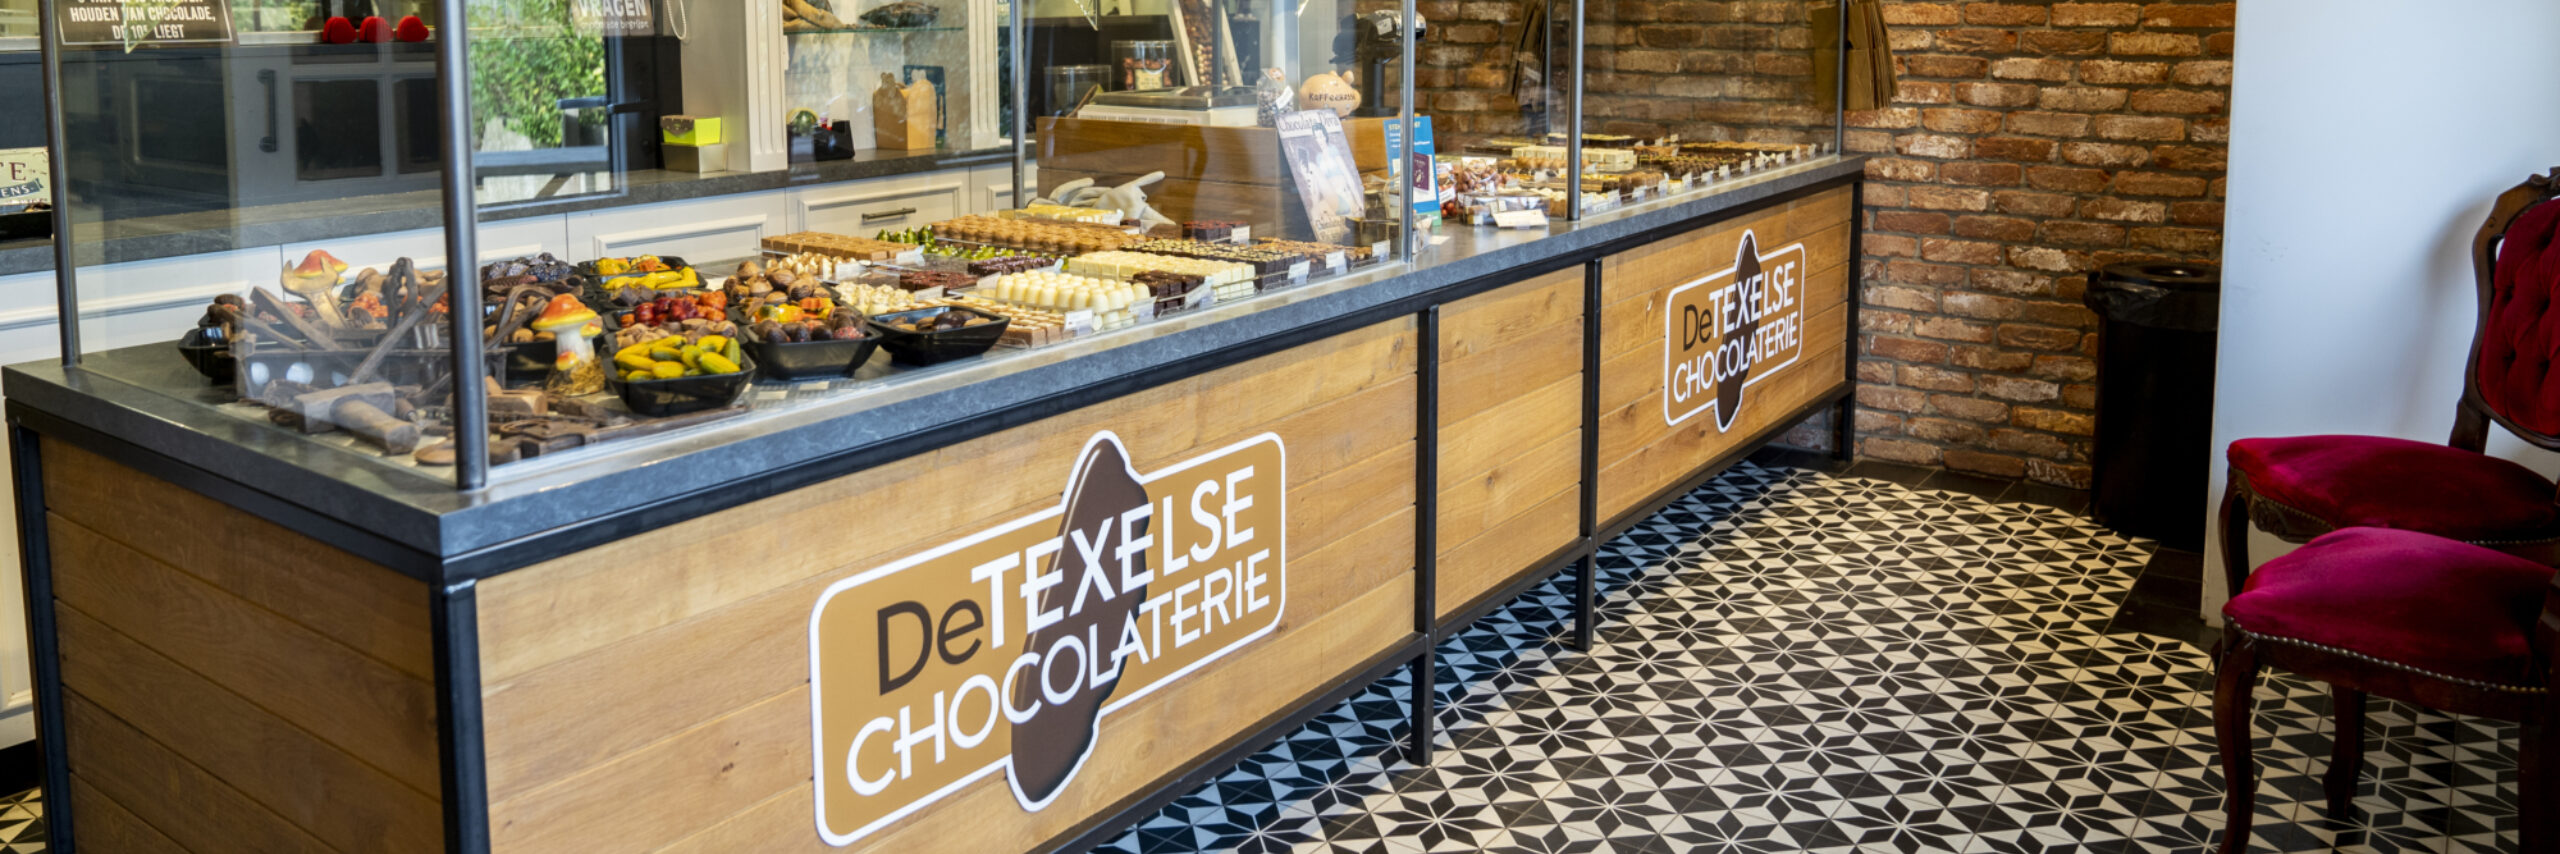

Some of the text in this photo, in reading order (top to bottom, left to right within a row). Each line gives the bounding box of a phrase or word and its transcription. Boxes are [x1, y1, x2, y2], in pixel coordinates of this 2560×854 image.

[69, 6, 120, 22] HOUDEN
[147, 5, 216, 22] CHOCOLADE,
[578, 0, 648, 17] VRAGEN
[153, 23, 185, 39] LIEGT
[1673, 311, 1798, 403] CHOCOLATERIE
[846, 547, 1270, 796] CHOCOLATERIE
